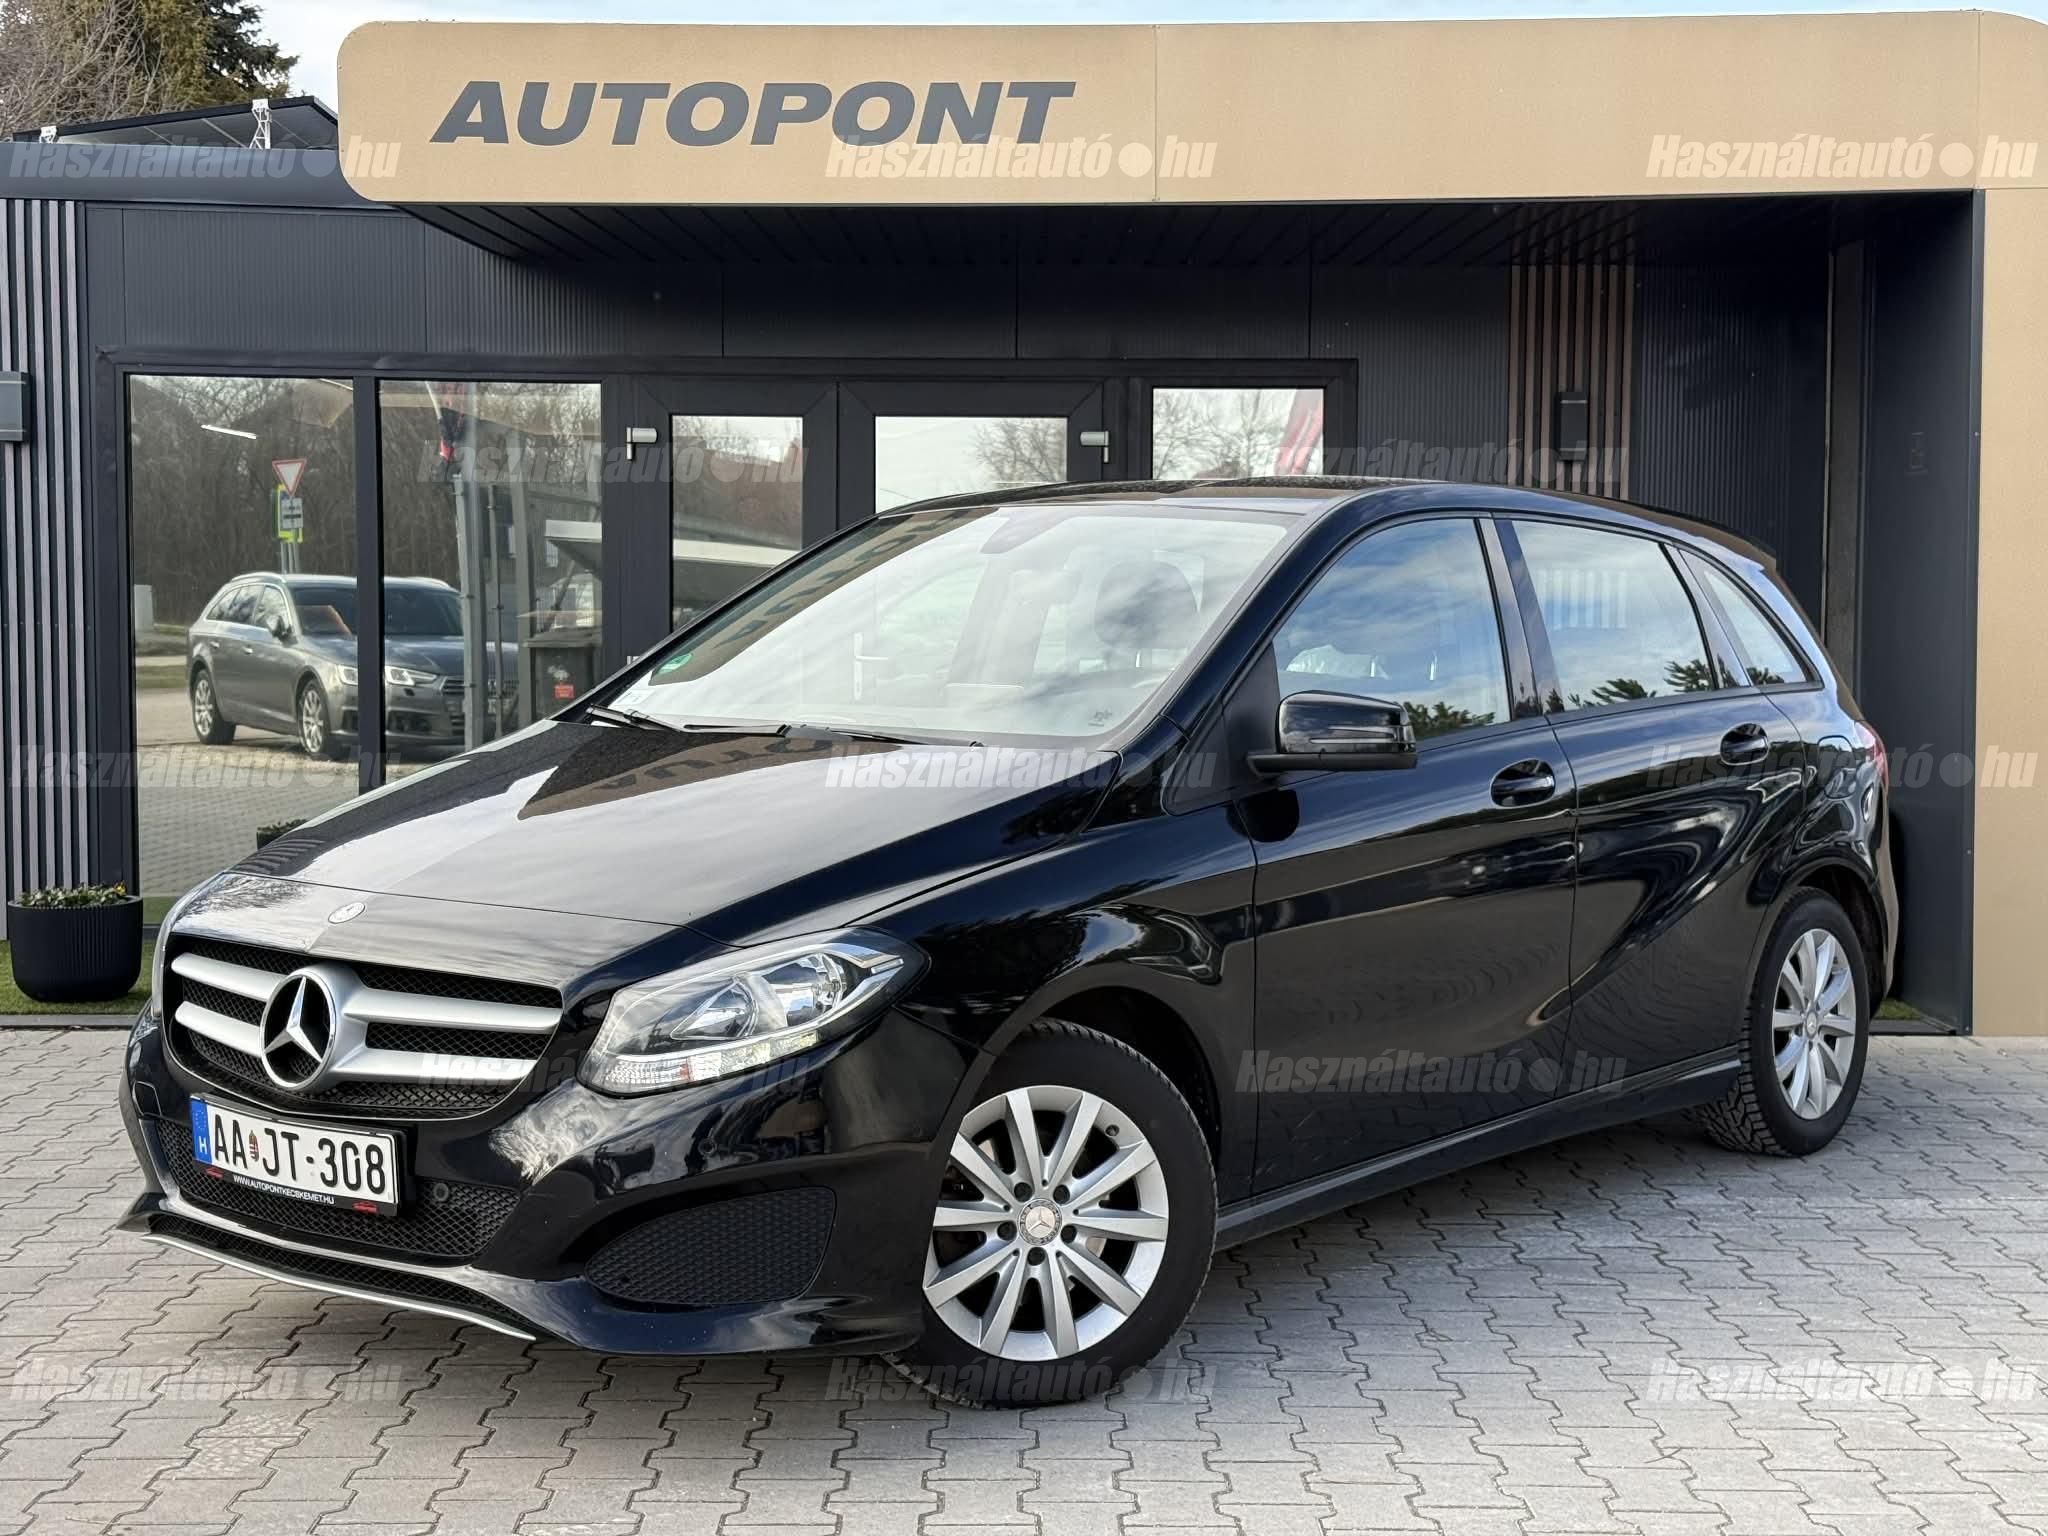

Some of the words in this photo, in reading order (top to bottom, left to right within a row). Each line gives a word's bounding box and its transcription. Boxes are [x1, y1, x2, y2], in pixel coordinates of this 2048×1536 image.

[430, 81, 1077, 146] AUTOPONT
[198, 1135, 207, 1154] H
[262, 1128, 386, 1194] JT-308
